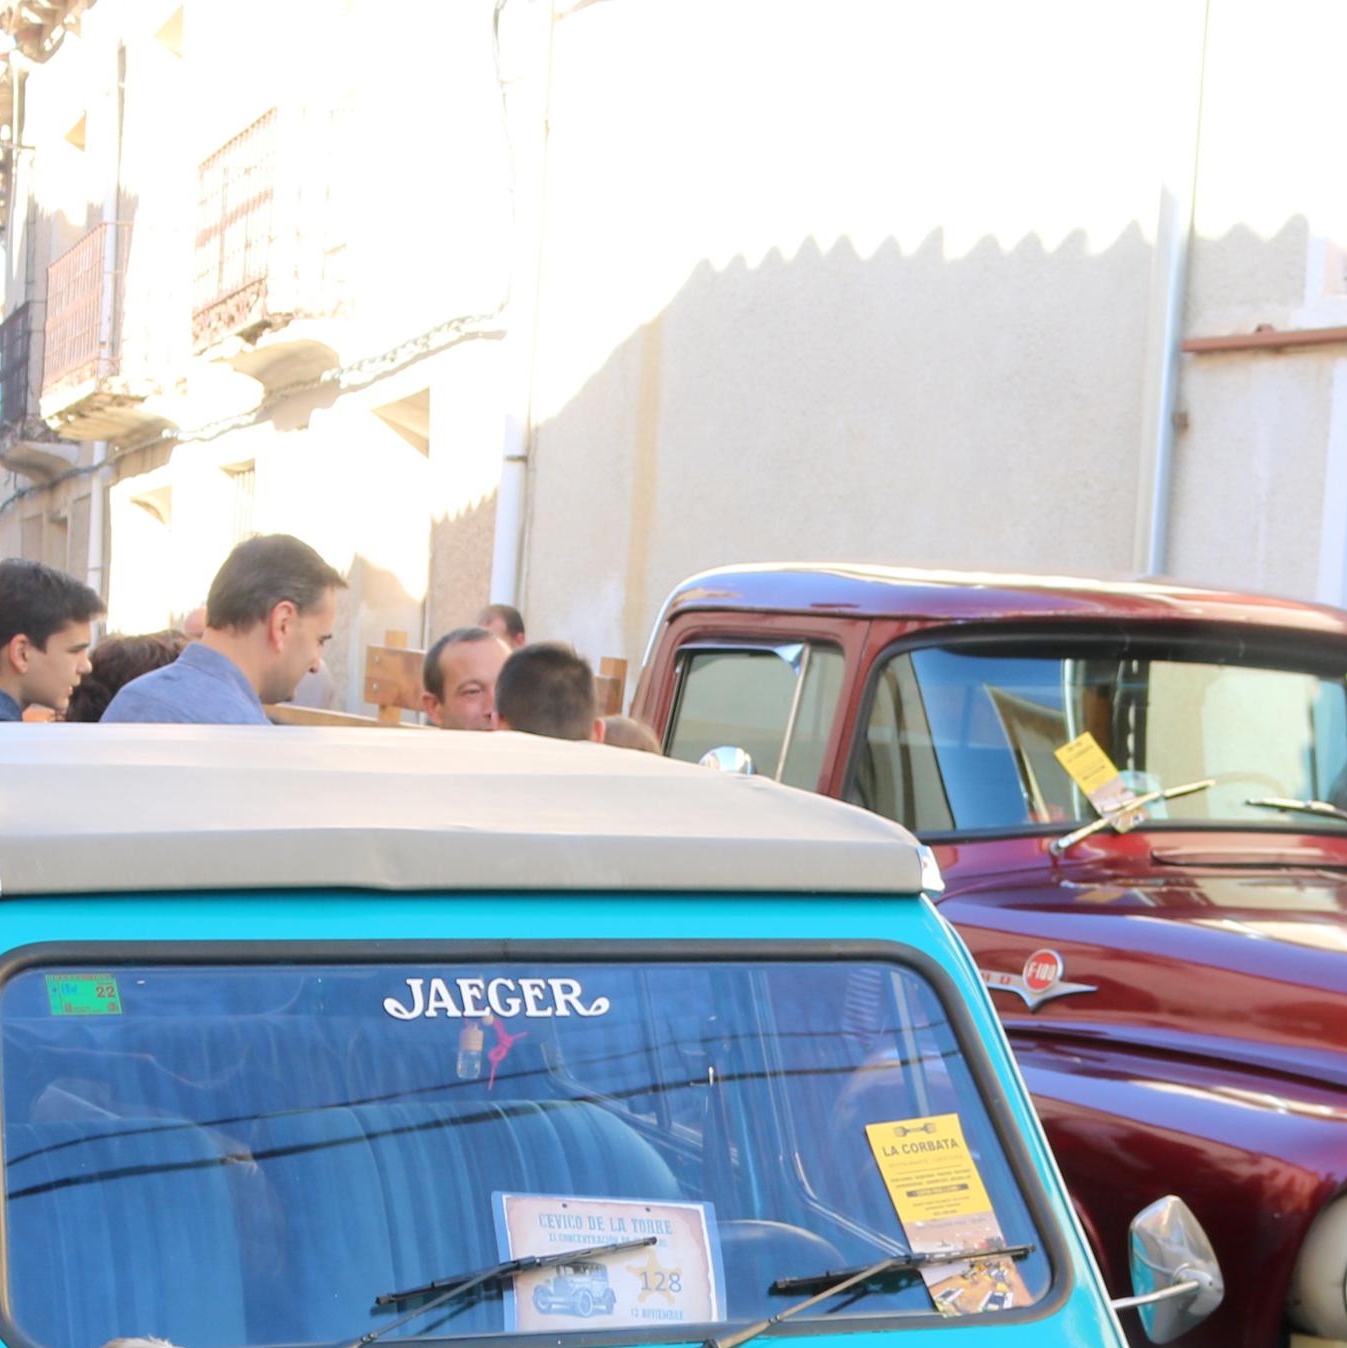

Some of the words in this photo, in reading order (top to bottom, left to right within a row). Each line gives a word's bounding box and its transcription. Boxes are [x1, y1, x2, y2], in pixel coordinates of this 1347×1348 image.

[1027, 961, 1057, 981] F-100
[96, 985, 115, 998] 22
[383, 977, 611, 1020] JAEGER
[882, 1145, 899, 1157] LA
[902, 1138, 959, 1155] CORBATA
[538, 1213, 583, 1231] CEVICO
[588, 1215, 605, 1232] DE
[609, 1217, 626, 1233] LA
[632, 1219, 673, 1236] TORRE
[639, 1271, 682, 1293] 128
